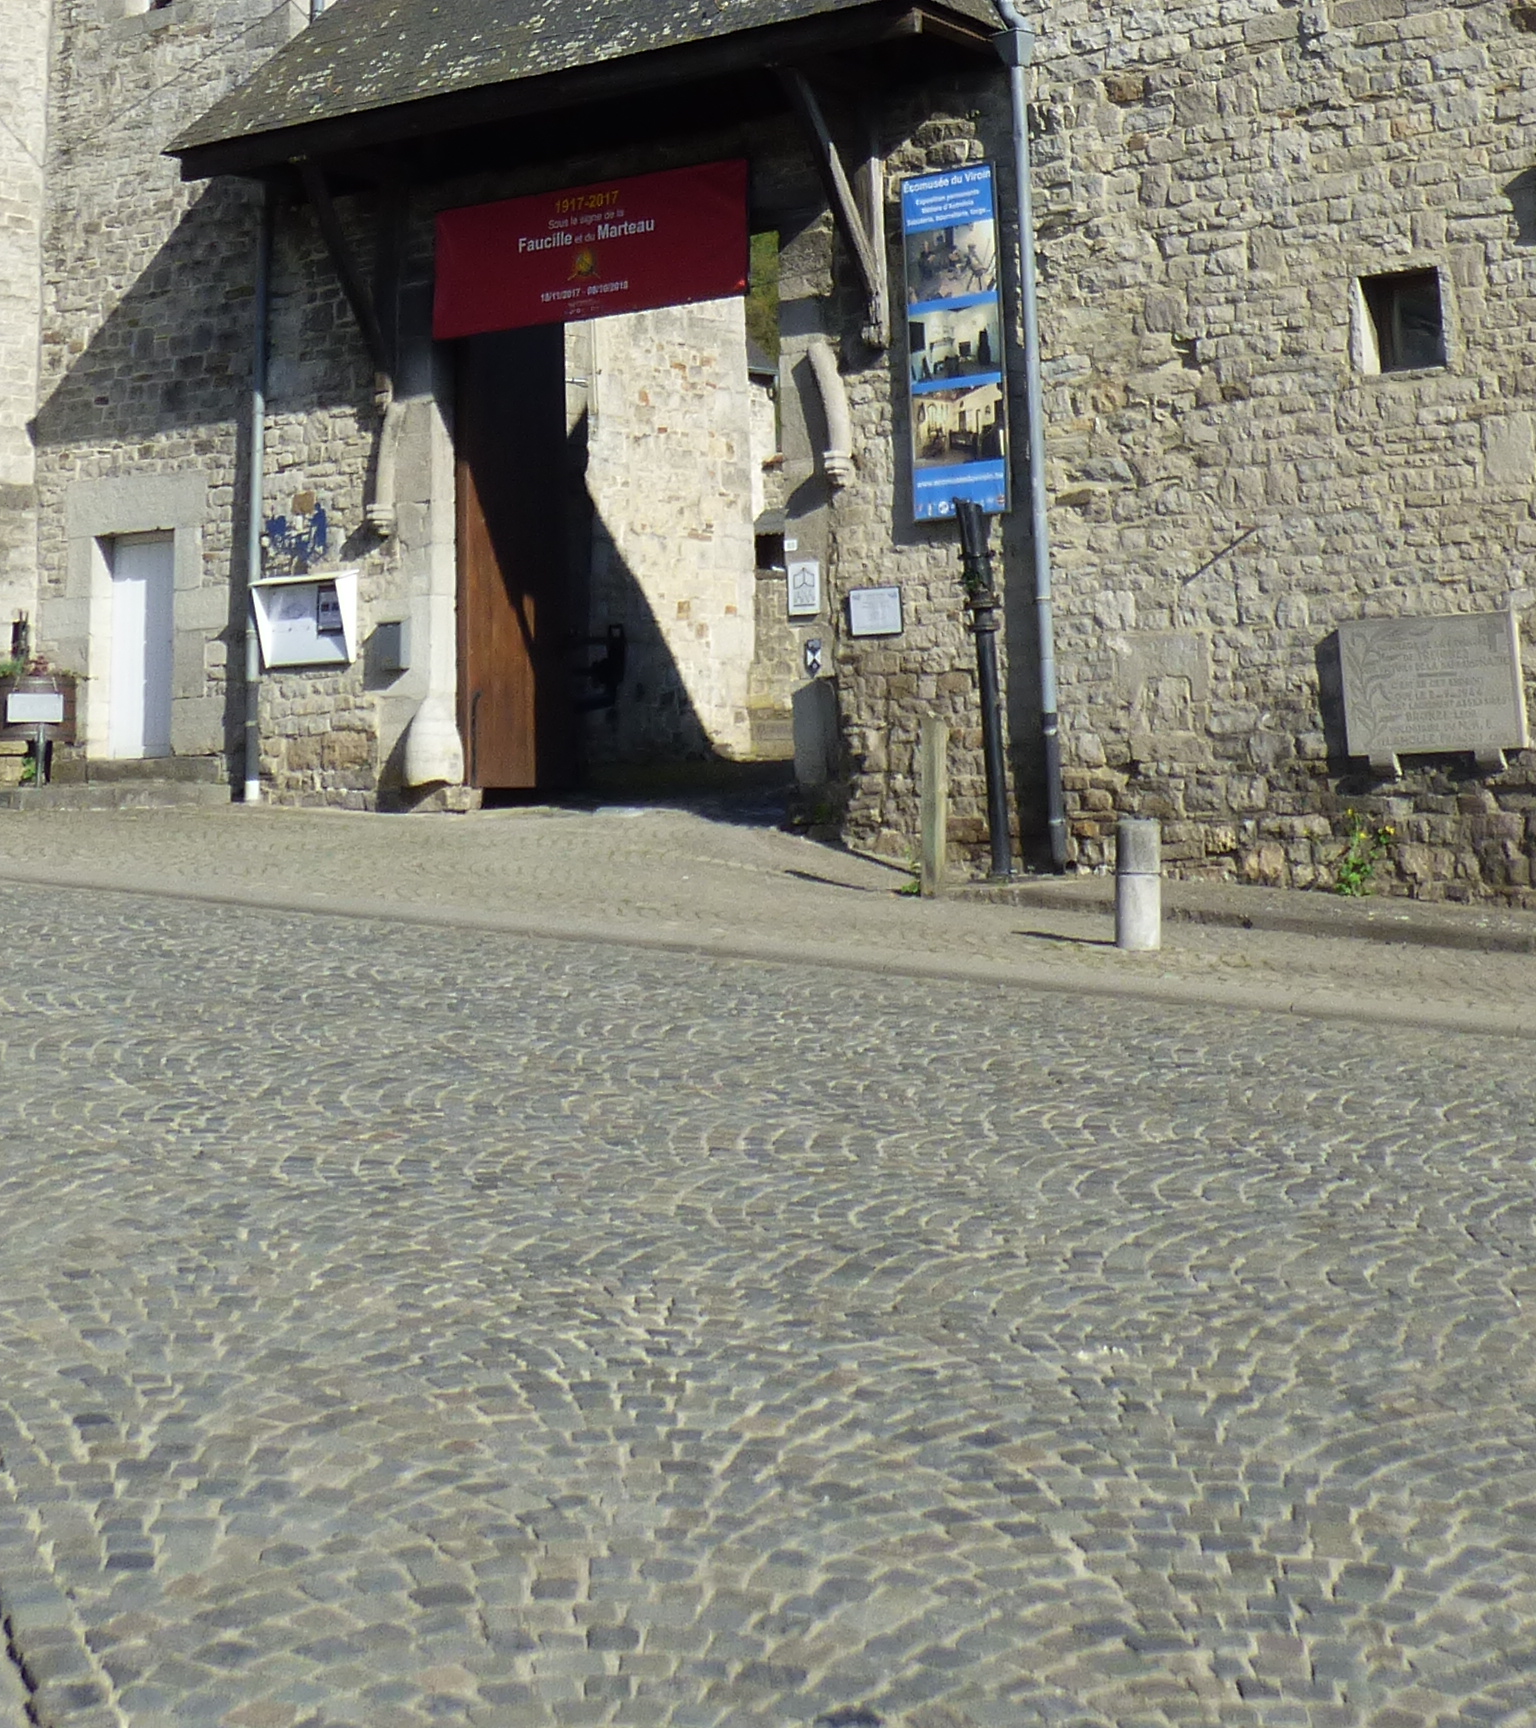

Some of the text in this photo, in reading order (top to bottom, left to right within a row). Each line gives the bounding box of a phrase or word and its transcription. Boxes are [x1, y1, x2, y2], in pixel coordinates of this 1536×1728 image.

[903, 169, 991, 194] Écomusée du Viroin
[555, 190, 619, 213] 1917-2017
[547, 218, 569, 230] Sous
[570, 215, 578, 225] le
[604, 210, 615, 220] de
[517, 218, 656, 253] Faucille et du Marteau
